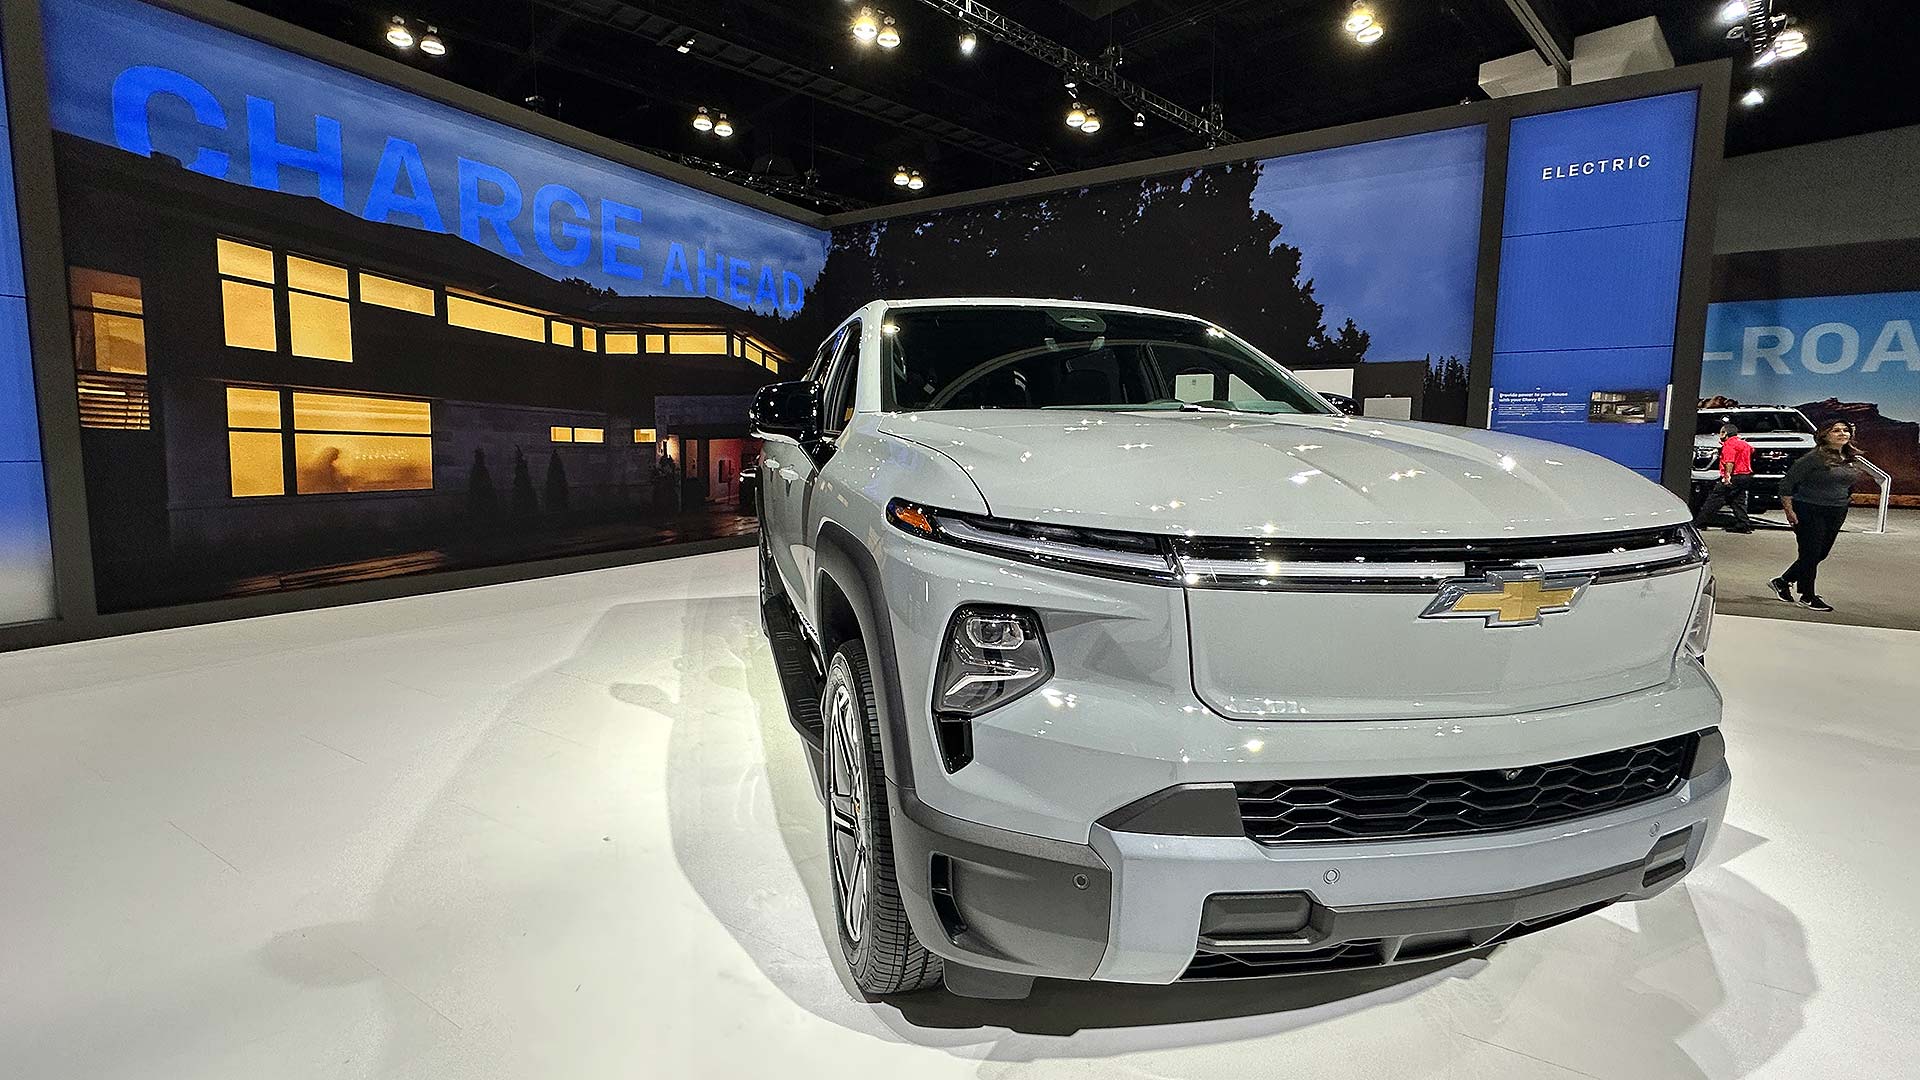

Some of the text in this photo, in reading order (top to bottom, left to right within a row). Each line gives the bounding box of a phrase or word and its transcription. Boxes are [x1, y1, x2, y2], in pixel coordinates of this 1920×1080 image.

[112, 65, 805, 312] CHARGE AHEAD
[1542, 154, 1651, 180] ELECTRIC
